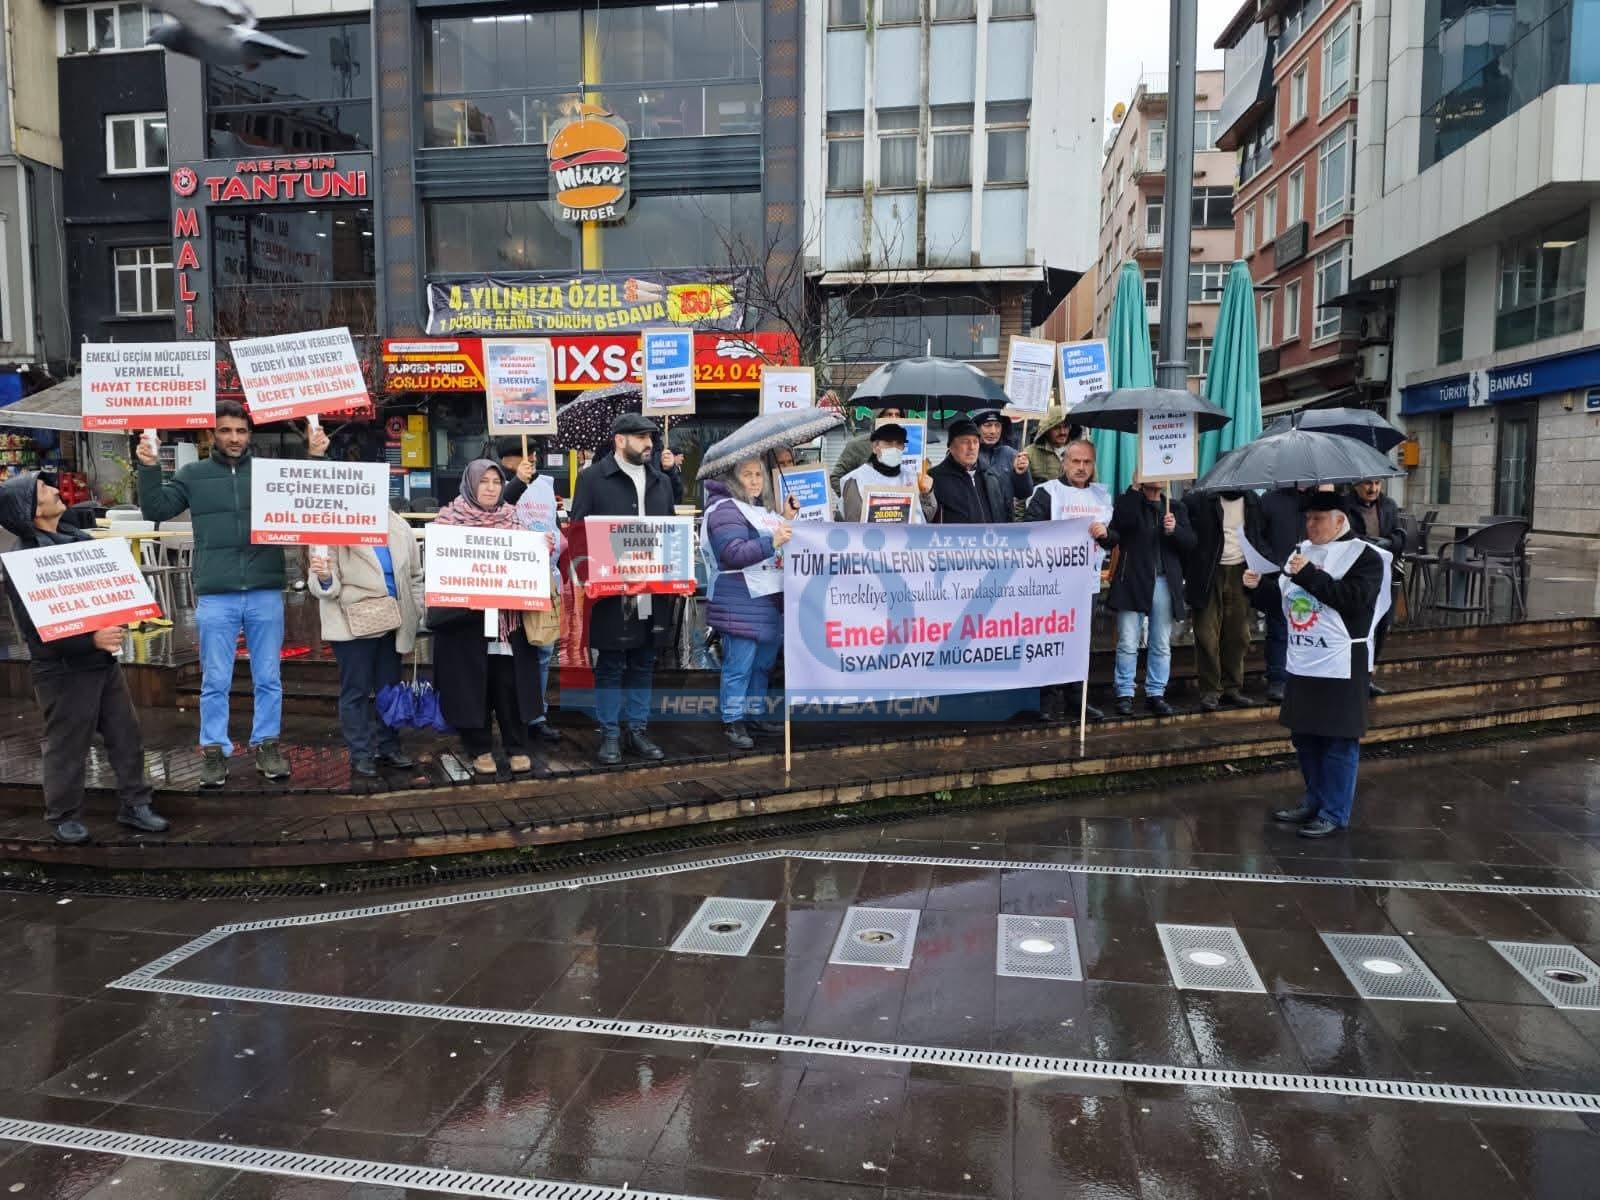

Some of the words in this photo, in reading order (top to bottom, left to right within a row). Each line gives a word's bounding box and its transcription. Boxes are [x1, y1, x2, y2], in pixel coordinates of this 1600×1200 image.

[563, 205, 616, 220] BURGER
[449, 284, 469, 311] 4.
[470, 286, 563, 310] YILIMIZA
[568, 279, 622, 308] ÖZEL
[450, 312, 491, 330] DÜRÜM
[496, 313, 533, 330] ALANA
[547, 311, 592, 330] DÜRÜM
[594, 301, 665, 331] BEDAVA
[234, 343, 275, 358] TORUNUNA
[276, 339, 307, 354] HARÇLIK
[308, 334, 351, 348] VEREMEYEN
[86, 350, 120, 362] EMEKLİ
[123, 349, 152, 364] GEÇİM
[155, 349, 211, 361] MÜCADELESİ
[251, 355, 286, 373] DEDEYİ
[288, 357, 307, 367] KİM
[308, 351, 343, 365] SEVER?
[114, 364, 184, 377] VERMEMELİ,
[730, 363, 742, 380] 0
[91, 382, 131, 392] HAYAT
[136, 379, 206, 391] TECRÜBESİ
[243, 376, 269, 389] İNSAN
[271, 371, 309, 384] ONURUNA
[431, 373, 478, 389] DÖNER
[1440, 384, 1469, 401] TÜRKİY
[1490, 372, 1532, 392] BANKASI
[256, 386, 296, 402] ÜCRET
[300, 379, 355, 397] VERİLSİN!
[778, 385, 798, 393] TEK
[105, 396, 192, 407] SUNMALIDIR!
[280, 467, 363, 480] EMEKLİNİN
[266, 482, 375, 496] GEÇİNEMEDİĞİ
[294, 497, 348, 511] DÜZEN,
[264, 511, 299, 523] ADİL
[301, 512, 376, 525] DEĞİLDİR!
[609, 522, 675, 534] EMEKLİNİN
[465, 534, 513, 547] EMEKLİ
[623, 538, 663, 548] HAKKI,
[34, 553, 66, 568] HANS
[66, 547, 108, 563] TATİLDE
[436, 547, 500, 559] SINIRININ
[503, 549, 540, 563] ÜSTÜ,
[632, 551, 655, 561] KUL
[791, 548, 824, 577] TÜM
[829, 548, 925, 576] EMEKLİLERİN
[928, 546, 1000, 573] SENDİKASI
[1003, 547, 1044, 569] FATSA
[1047, 541, 1089, 573] ŞUBESİ
[36, 569, 73, 584] HASAN
[74, 561, 120, 577] KAHVEDE
[472, 563, 508, 576] AÇLIK
[612, 564, 673, 575] HAKKIDIR!
[28, 590, 58, 602] HAKKI
[58, 578, 113, 597] ÖDENMEYEN
[439, 576, 503, 588] SINIRININ
[507, 579, 538, 591] ALTI!
[830, 583, 887, 610] Emekliye
[890, 581, 950, 607] yoksulluk.
[952, 575, 1015, 602] Yandaşlara
[1018, 576, 1061, 597] saltanat.
[48, 602, 90, 615] HELAL
[92, 589, 136, 606] OLMAZ!
[825, 615, 954, 648] Emekliler
[960, 608, 1076, 641] Alanlarda!
[840, 649, 935, 673] İSYANDAYIZ
[939, 645, 1022, 666] MÜCADELE
[1025, 641, 1065, 664] ŞART!
[575, 1019, 631, 1033] Ordu
[776, 1036, 898, 1055] Belediyesi
